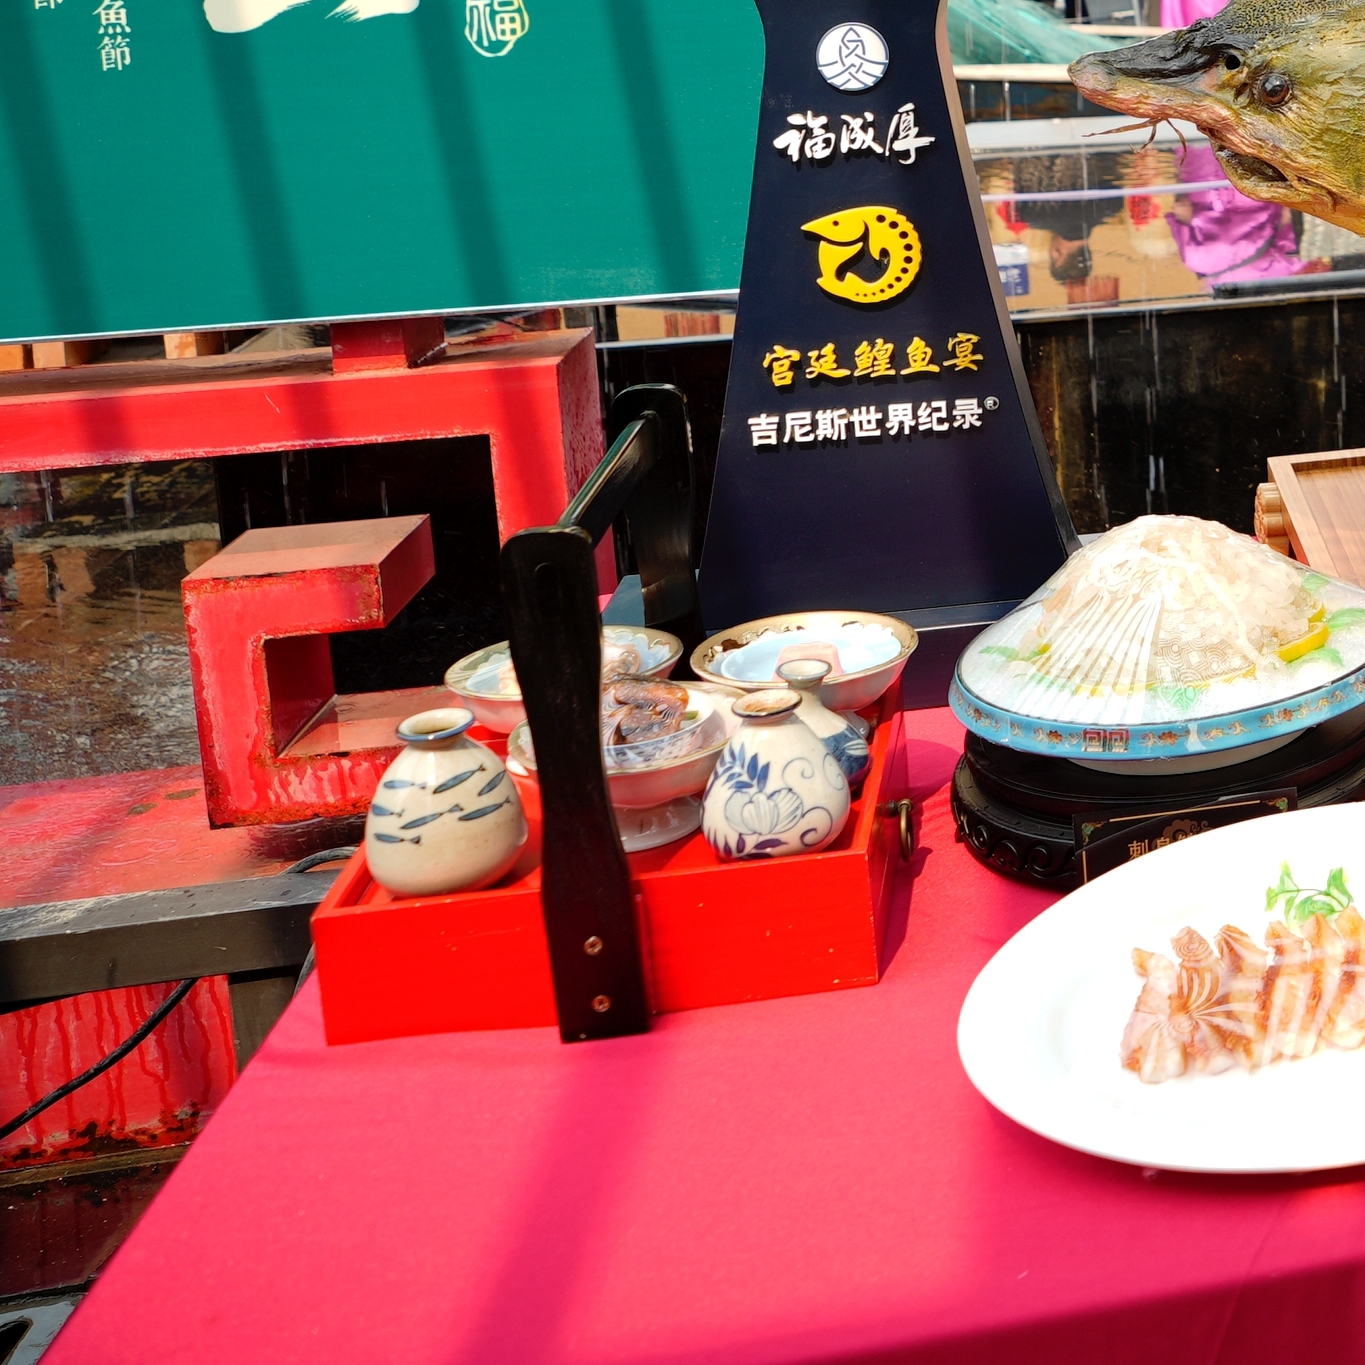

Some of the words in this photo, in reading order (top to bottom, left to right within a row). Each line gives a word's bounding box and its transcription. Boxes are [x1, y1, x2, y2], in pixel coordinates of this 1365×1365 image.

[772, 102, 936, 166] 福成厚
[762, 331, 985, 388] 宫廷鳇鱼宴
[747, 396, 984, 448] 吉尼斯世界纪录
